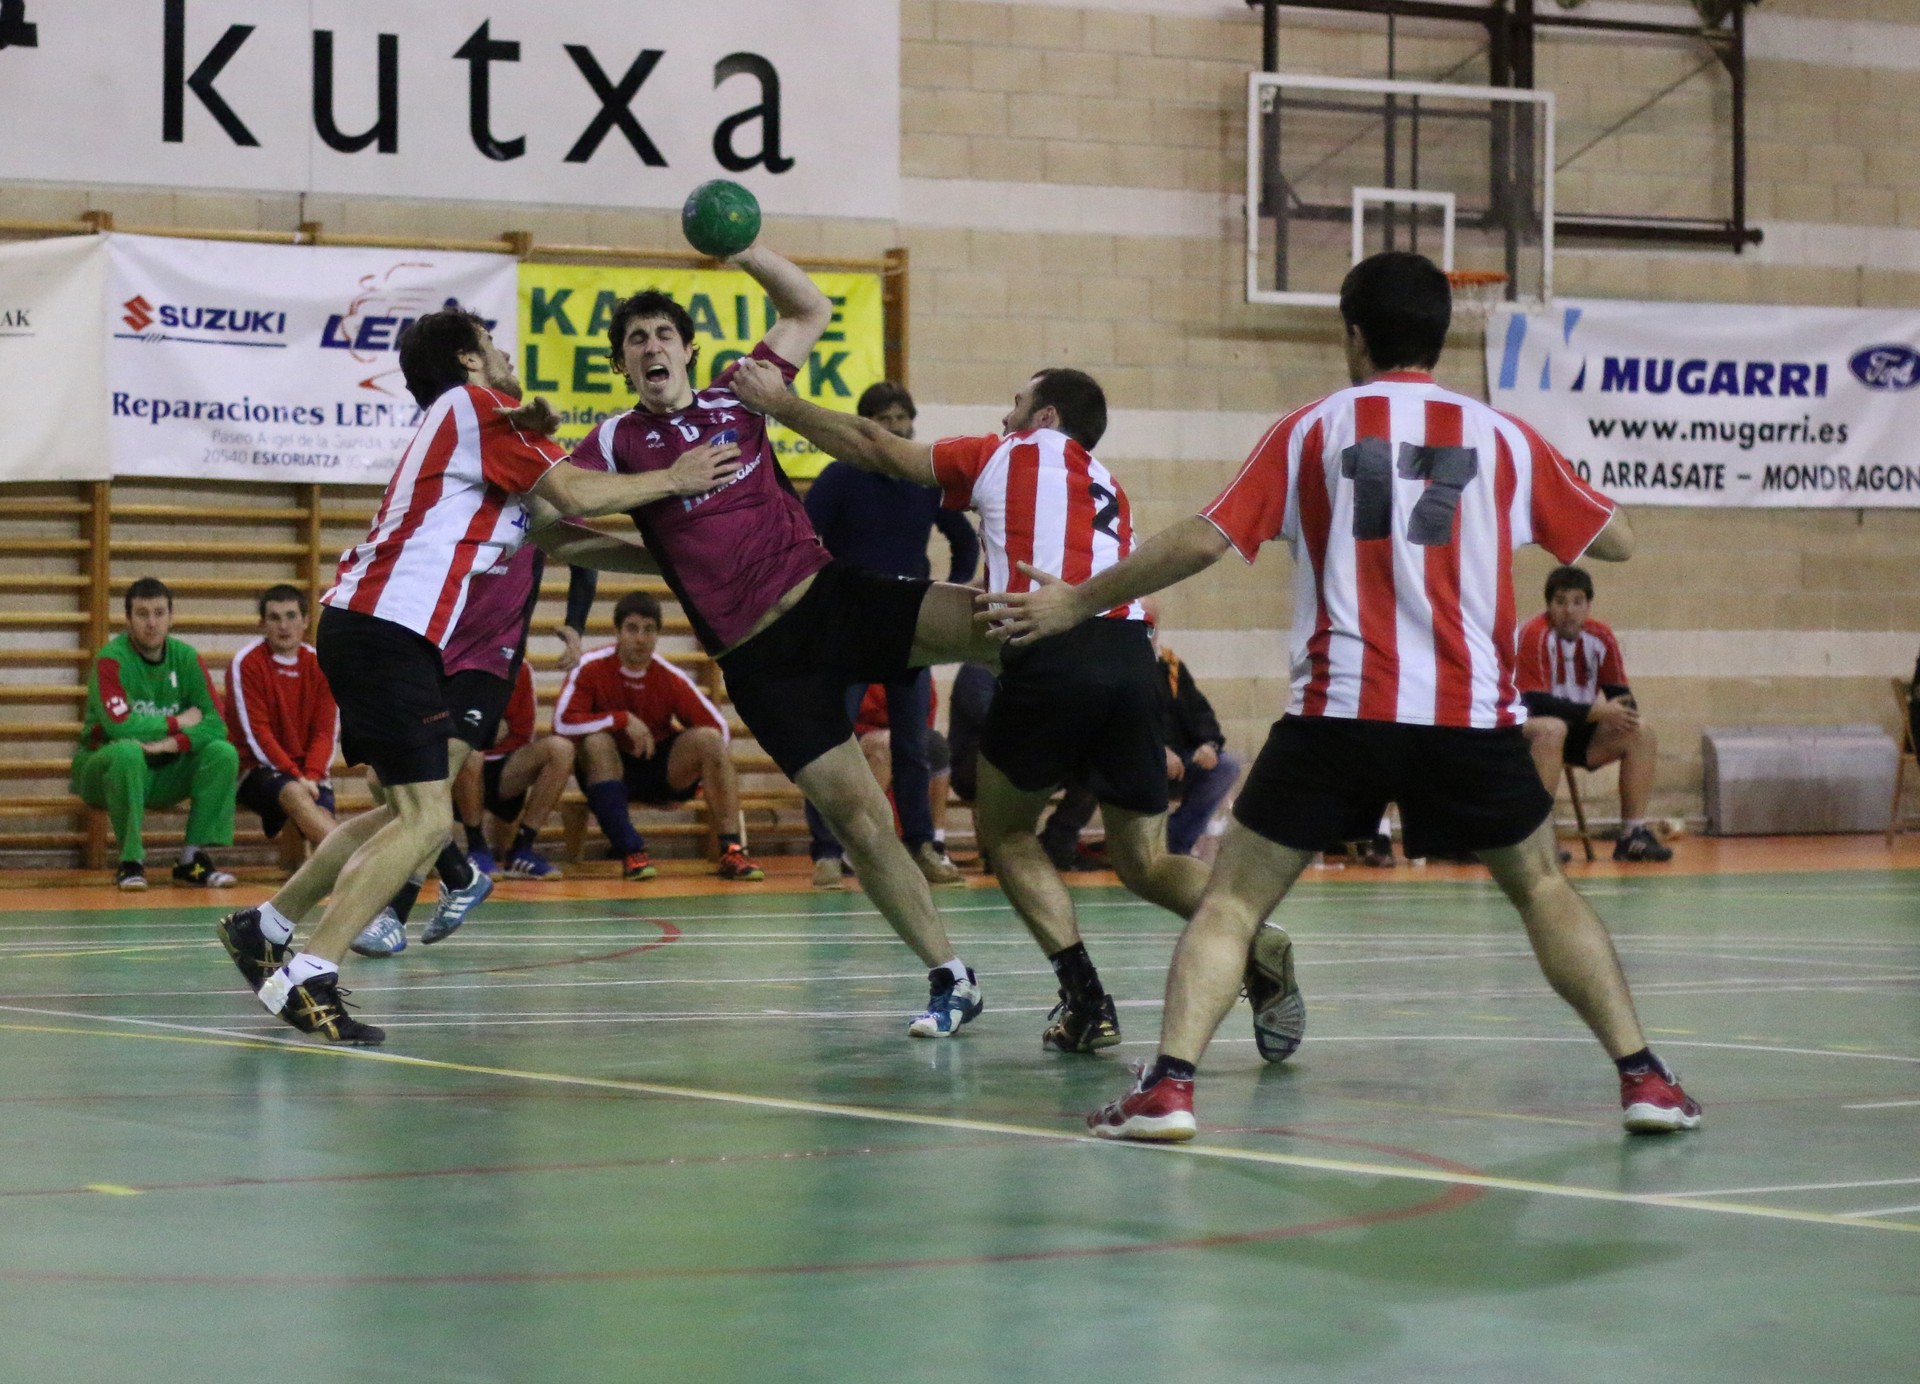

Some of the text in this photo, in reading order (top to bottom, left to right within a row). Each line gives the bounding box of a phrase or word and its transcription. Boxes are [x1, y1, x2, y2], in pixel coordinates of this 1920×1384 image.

[161, 0, 796, 175] kutxa
[159, 304, 287, 334] SUZUKI
[530, 286, 847, 341] KAAIE
[1601, 356, 1829, 397] MUGARRI
[112, 391, 325, 425] Reparaciones
[1588, 414, 1849, 450] www.mugarri.es
[252, 450, 341, 468] ESKORIATZA
[1602, 460, 1726, 490] ARRASATE
[1762, 463, 1920, 493] MONDRAGON
[1342, 435, 1478, 545] 17
[1088, 482, 1123, 544] 2
